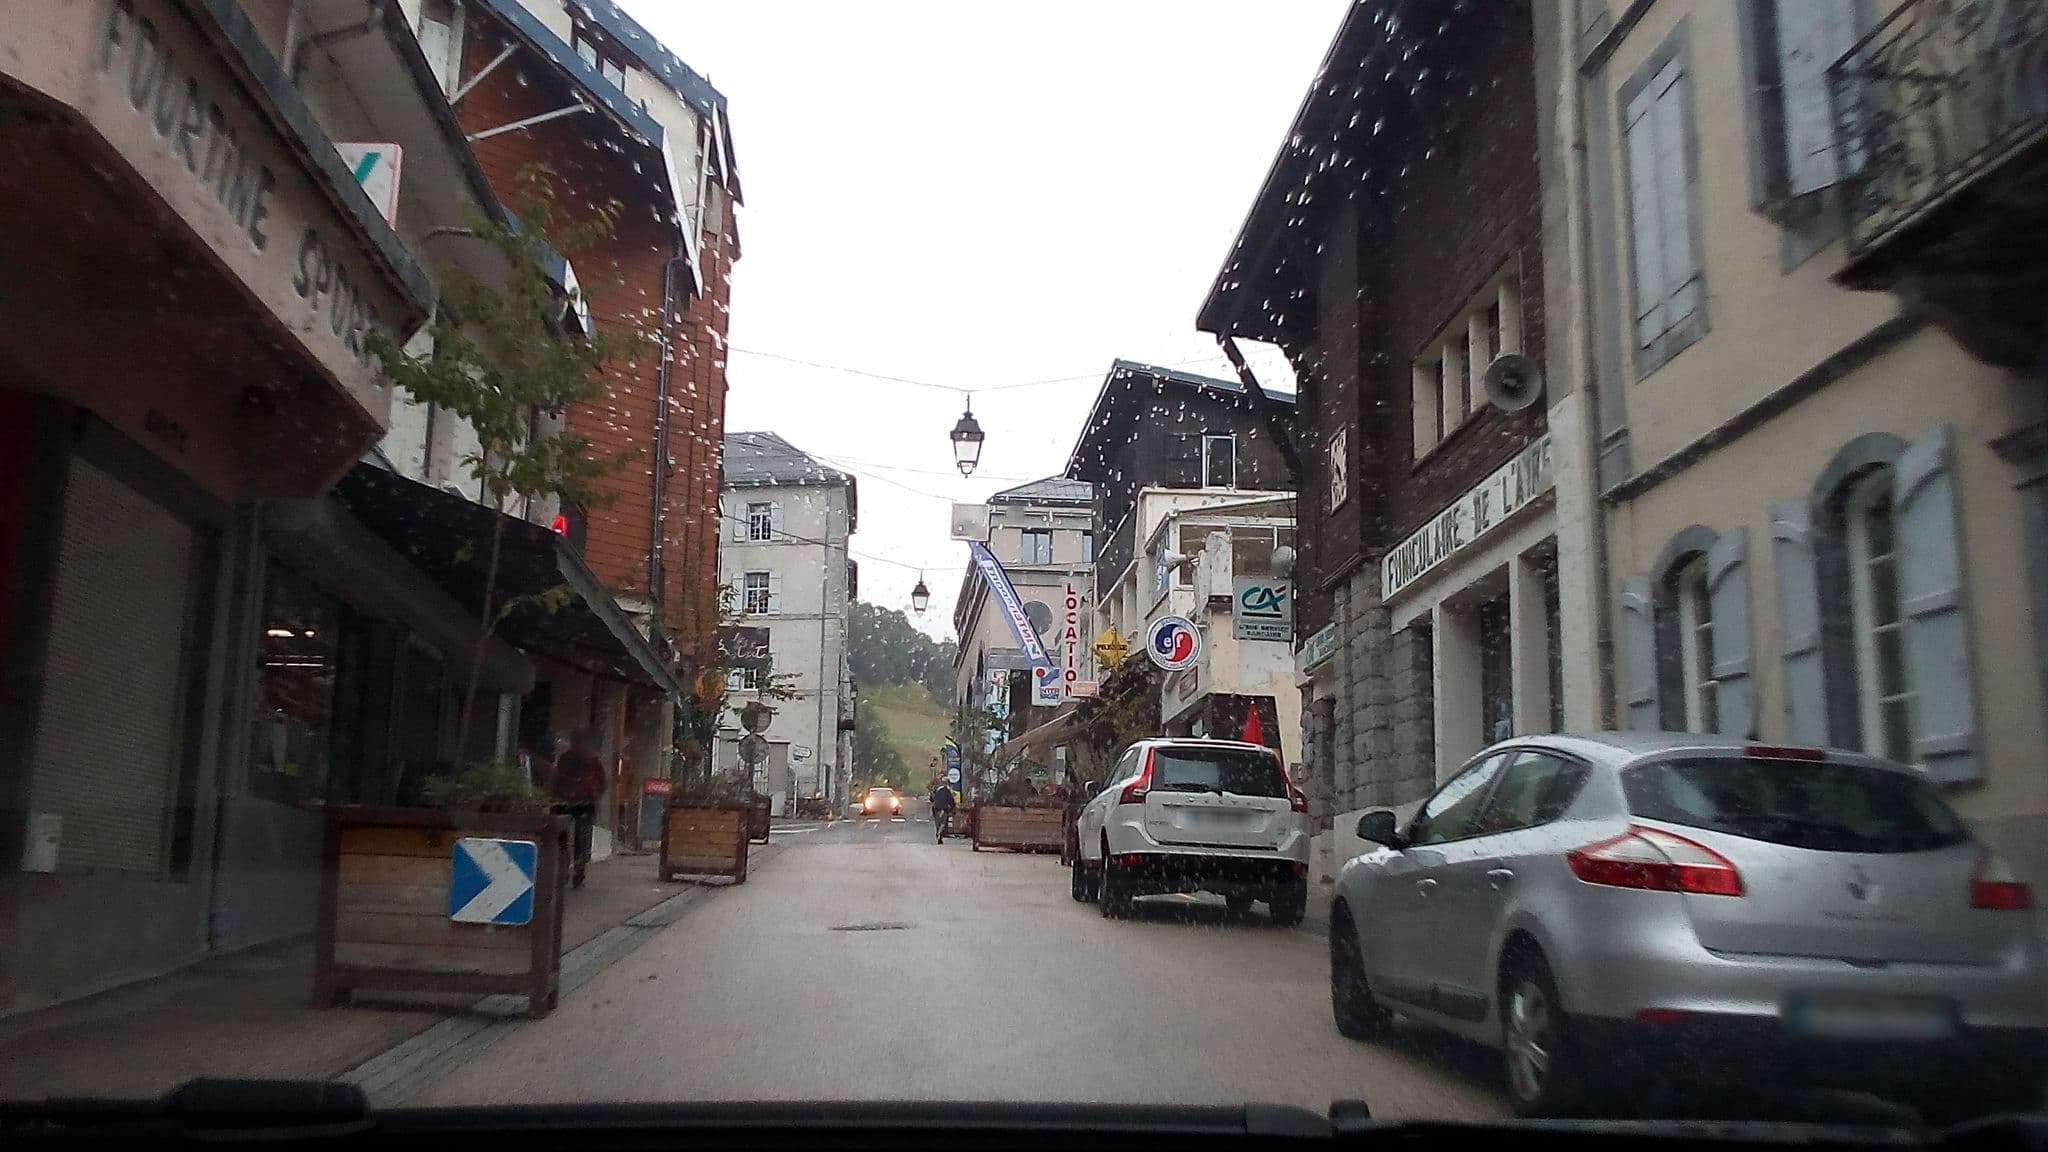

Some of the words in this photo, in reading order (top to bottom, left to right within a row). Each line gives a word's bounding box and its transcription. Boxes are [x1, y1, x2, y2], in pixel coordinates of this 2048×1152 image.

[292, 228, 390, 388] SPORT
[1388, 505, 1465, 594] FUNICULAIRE
[1473, 489, 1490, 537] DE
[1064, 583, 1078, 697] LOCATION
